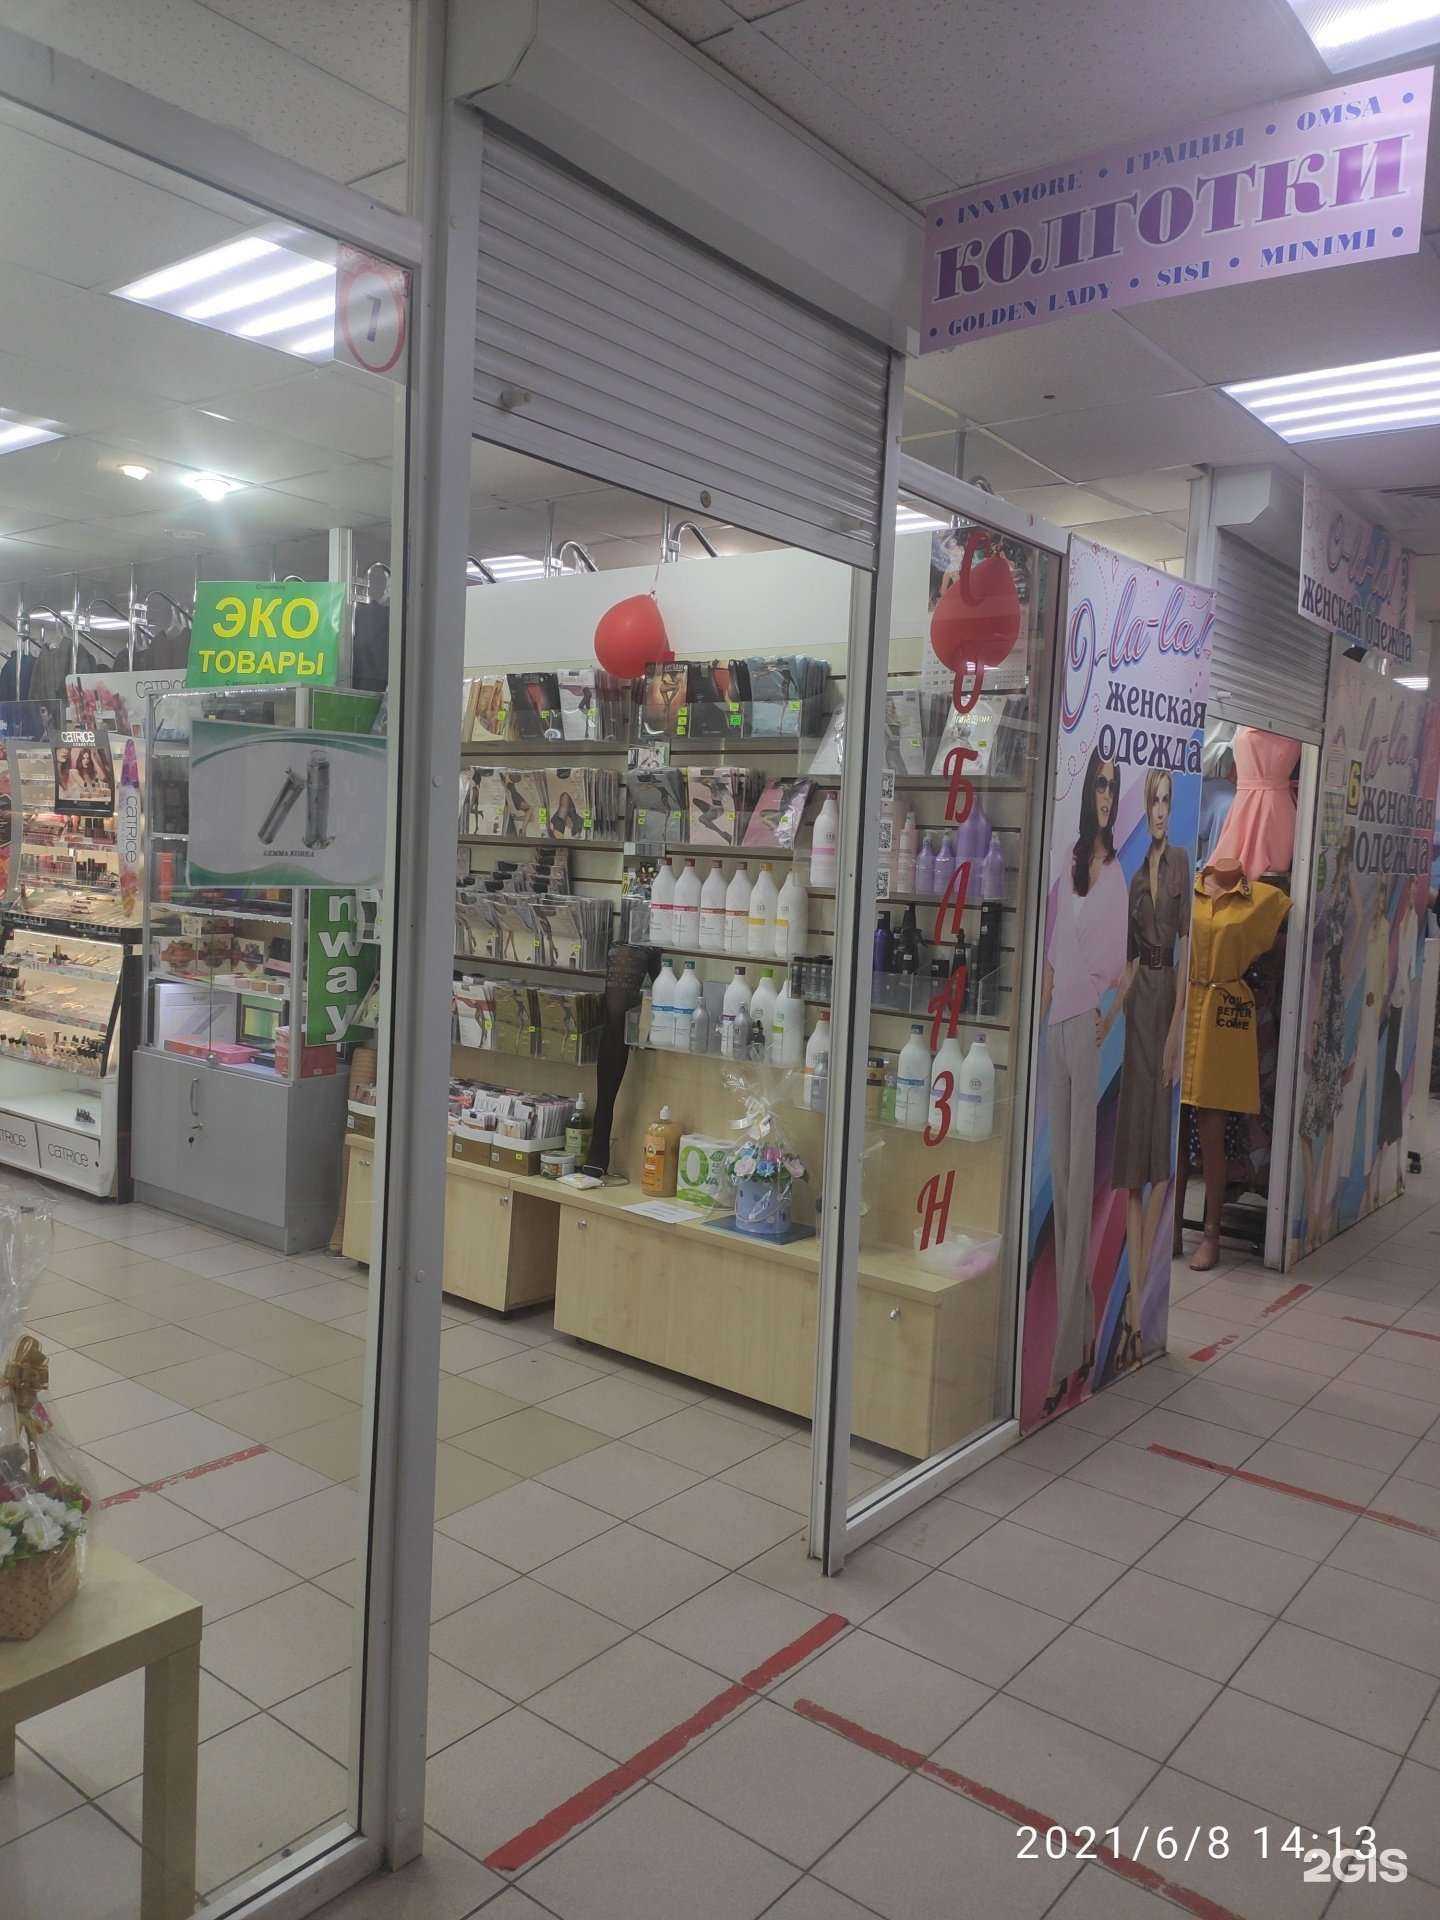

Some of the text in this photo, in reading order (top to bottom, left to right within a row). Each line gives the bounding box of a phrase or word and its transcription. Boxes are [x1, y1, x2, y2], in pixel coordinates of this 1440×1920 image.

[957, 95, 1382, 224] INNAMORE ГРАЦИЯ OMSA
[933, 134, 1411, 301] КОЛГОТКИ
[948, 227, 1377, 337] GOLDEN LADY SISI MINIMI
[212, 596, 319, 639] ЭКО
[1302, 574, 1361, 636] женская
[1366, 613, 1412, 662] одежда
[199, 650, 324, 675] ТОВАРЫ
[1106, 680, 1207, 729] женская
[1100, 723, 1203, 774] одежда
[1359, 785, 1432, 829] женская
[1355, 831, 1430, 874] одежда
